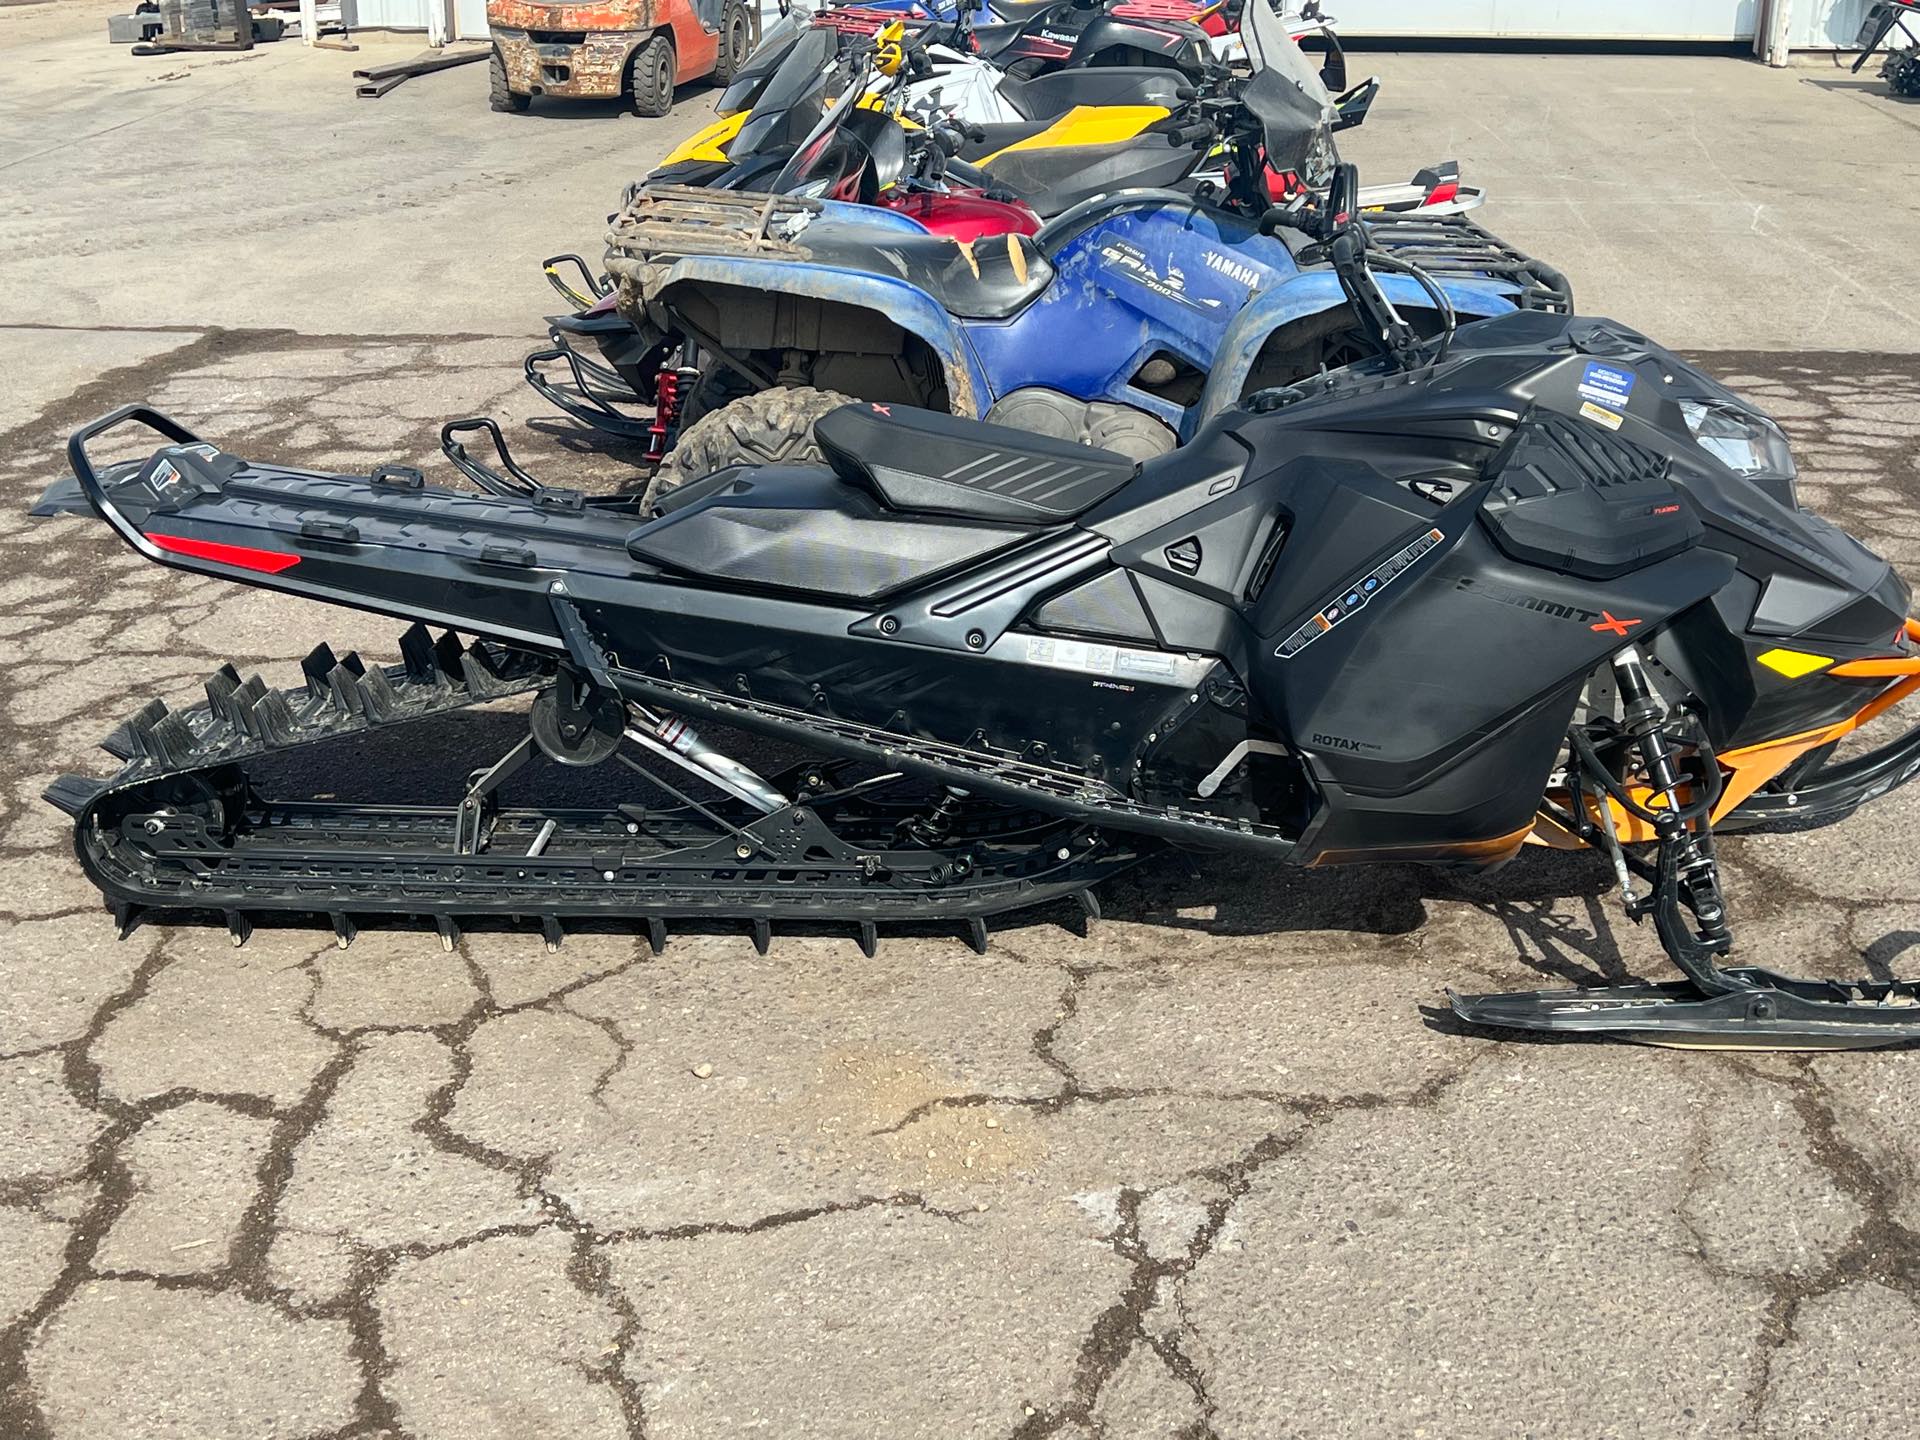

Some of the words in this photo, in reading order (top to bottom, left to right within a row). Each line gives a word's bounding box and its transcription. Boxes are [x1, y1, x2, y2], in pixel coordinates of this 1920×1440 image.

[1041, 28, 1079, 43] Kawasa
[1205, 250, 1261, 289] YAMAHA
[1590, 610, 1643, 637] X
[1312, 733, 1360, 751] ROTAX
